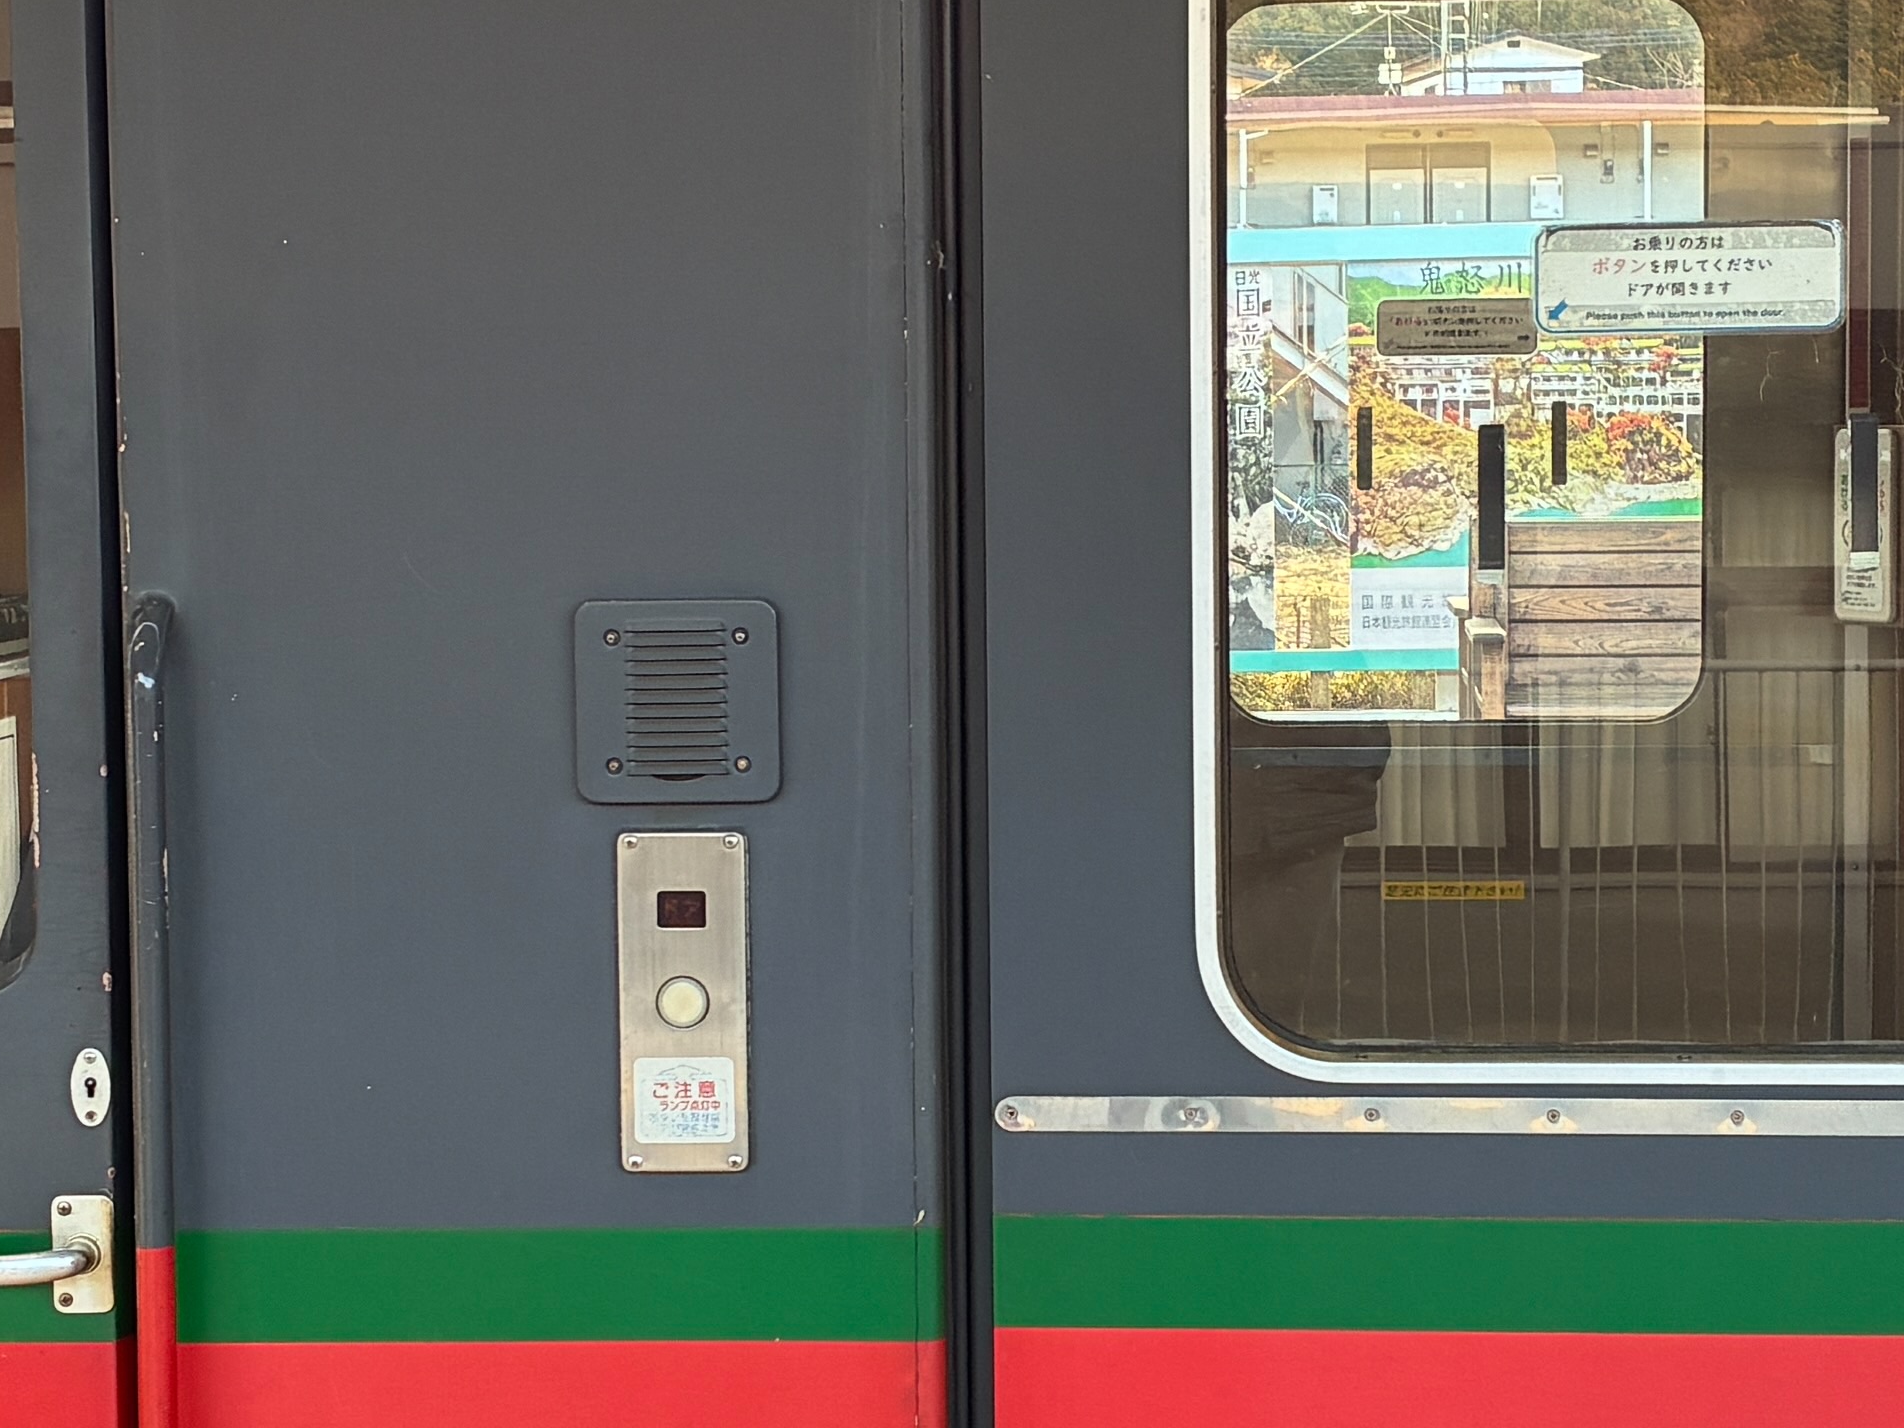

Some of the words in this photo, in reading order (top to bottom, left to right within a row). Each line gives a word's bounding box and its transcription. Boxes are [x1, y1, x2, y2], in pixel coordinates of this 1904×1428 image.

[1633, 235, 1724, 251] お乗りの方は
[1592, 257, 1773, 275] ボタンを押してください
[1420, 262, 1522, 294] 鬼怒川
[1627, 281, 1732, 298] ドアが開きます
[653, 1080, 717, 1099] ご注意
